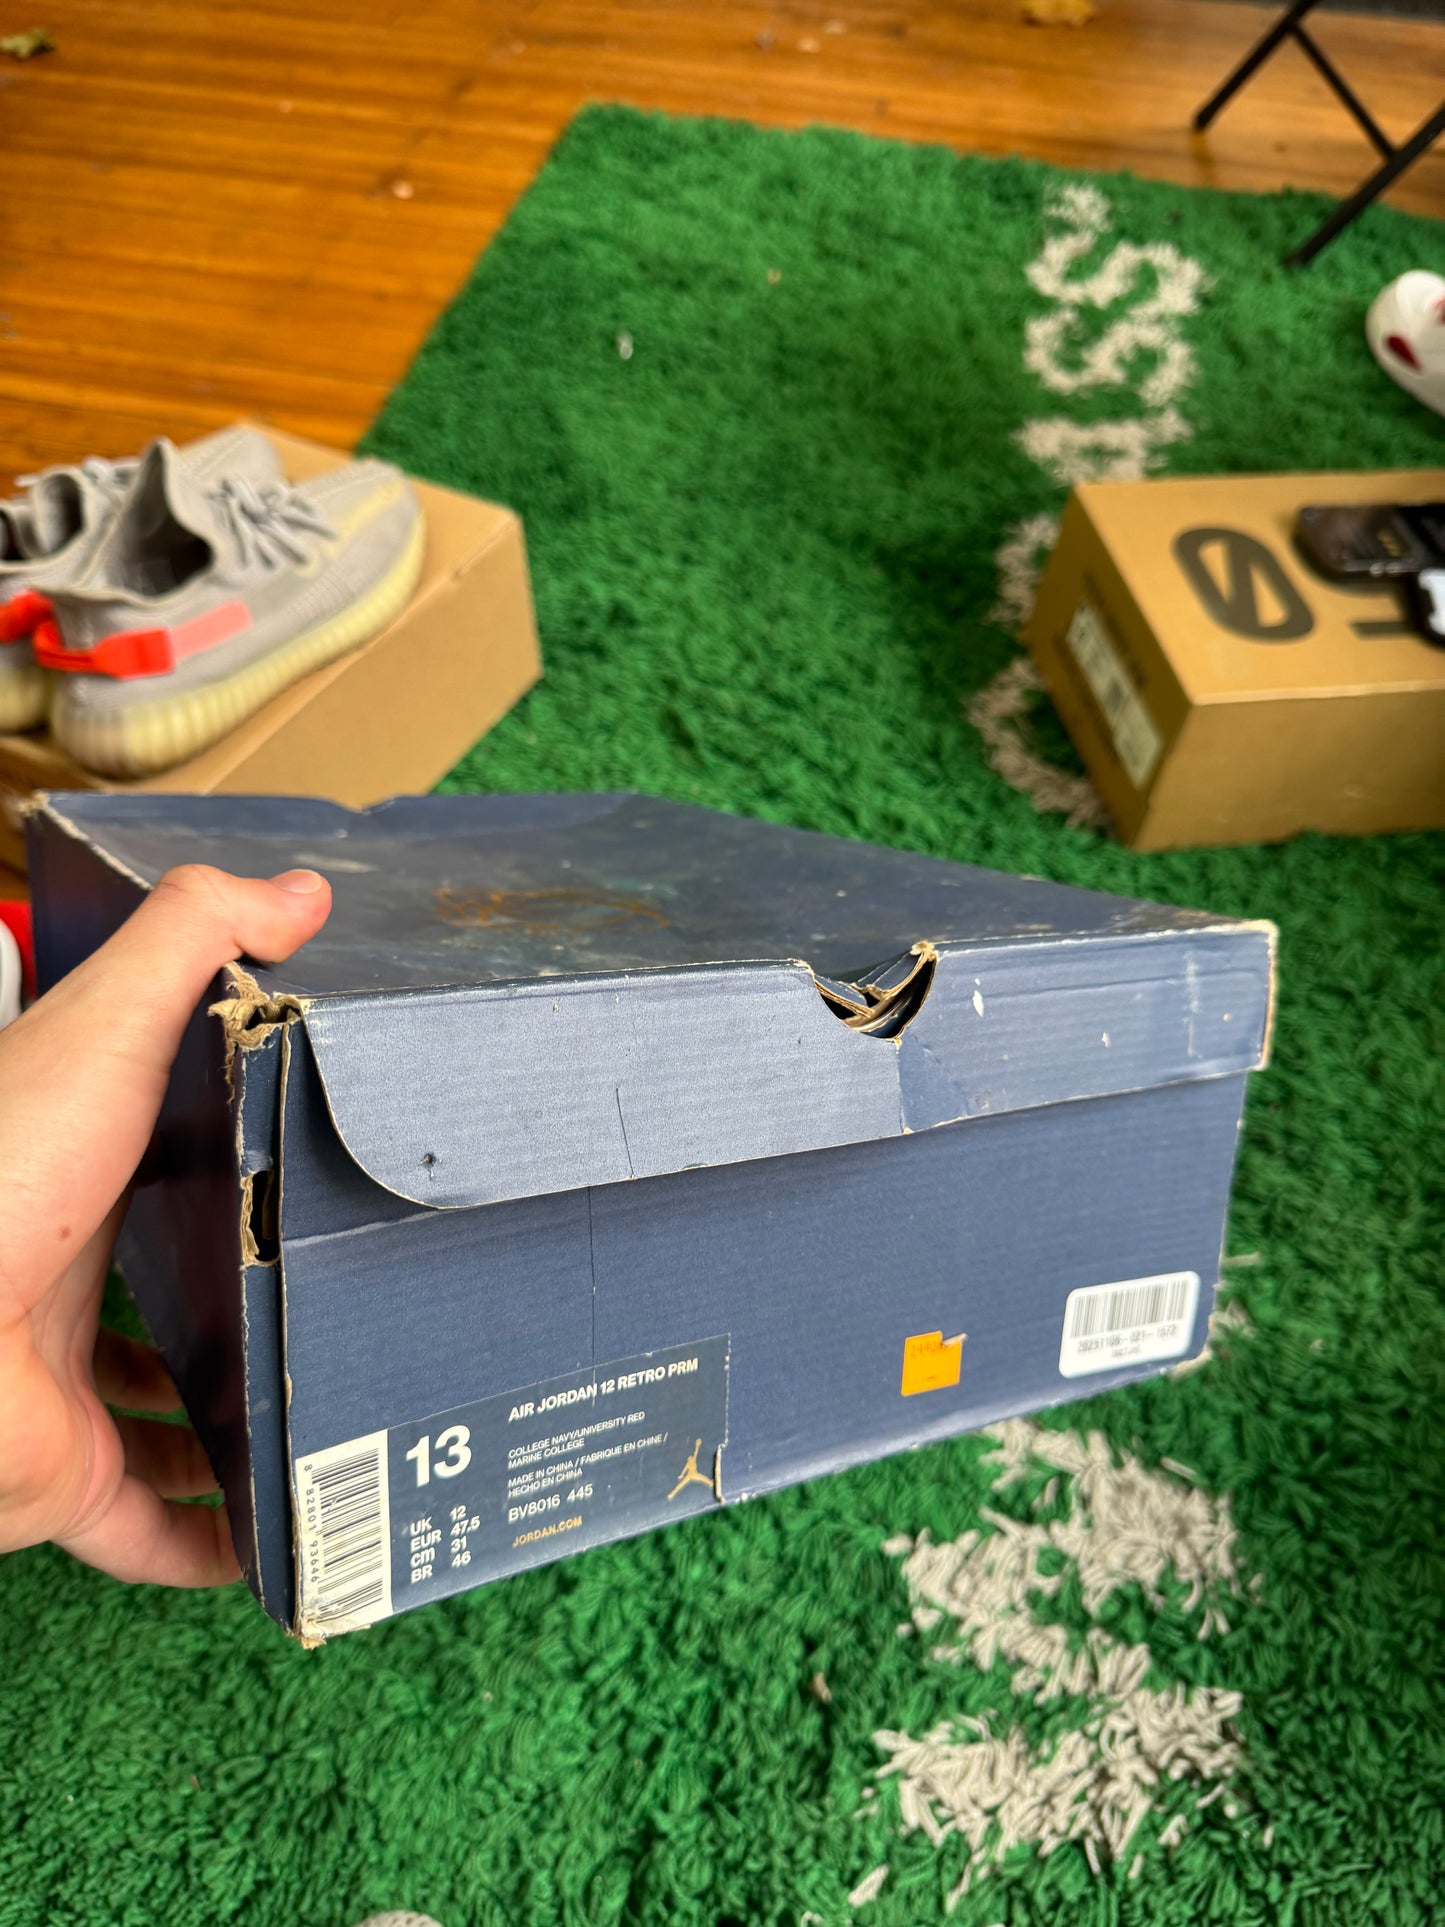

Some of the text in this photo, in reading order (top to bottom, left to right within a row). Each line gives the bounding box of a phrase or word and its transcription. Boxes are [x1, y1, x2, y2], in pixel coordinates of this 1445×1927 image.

[508, 1357, 699, 1422] AIR JORDAN 12 RETRO PRM
[508, 1411, 646, 1460] COLLEGE NAVY/UNIVERSITY RED
[406, 1424, 472, 1488] 13
[508, 1438, 585, 1470] MARINE COLLEGE
[508, 1472, 534, 1489] MADE
[535, 1468, 545, 1479] IN
[547, 1460, 573, 1476] CHINA
[580, 1447, 622, 1465] FABRIQUE
[623, 1443, 636, 1454] EN
[636, 1433, 663, 1449] CHINE
[508, 1467, 583, 1499] HECHO EN CHINA
[410, 1505, 467, 1536] UK 12
[508, 1483, 594, 1524] BV8016 445
[410, 1515, 480, 1554] EUR 47.5
[451, 1536, 467, 1553] 31
[512, 1515, 583, 1548] JORDAN.COM
[411, 1550, 472, 1584] BR 46
